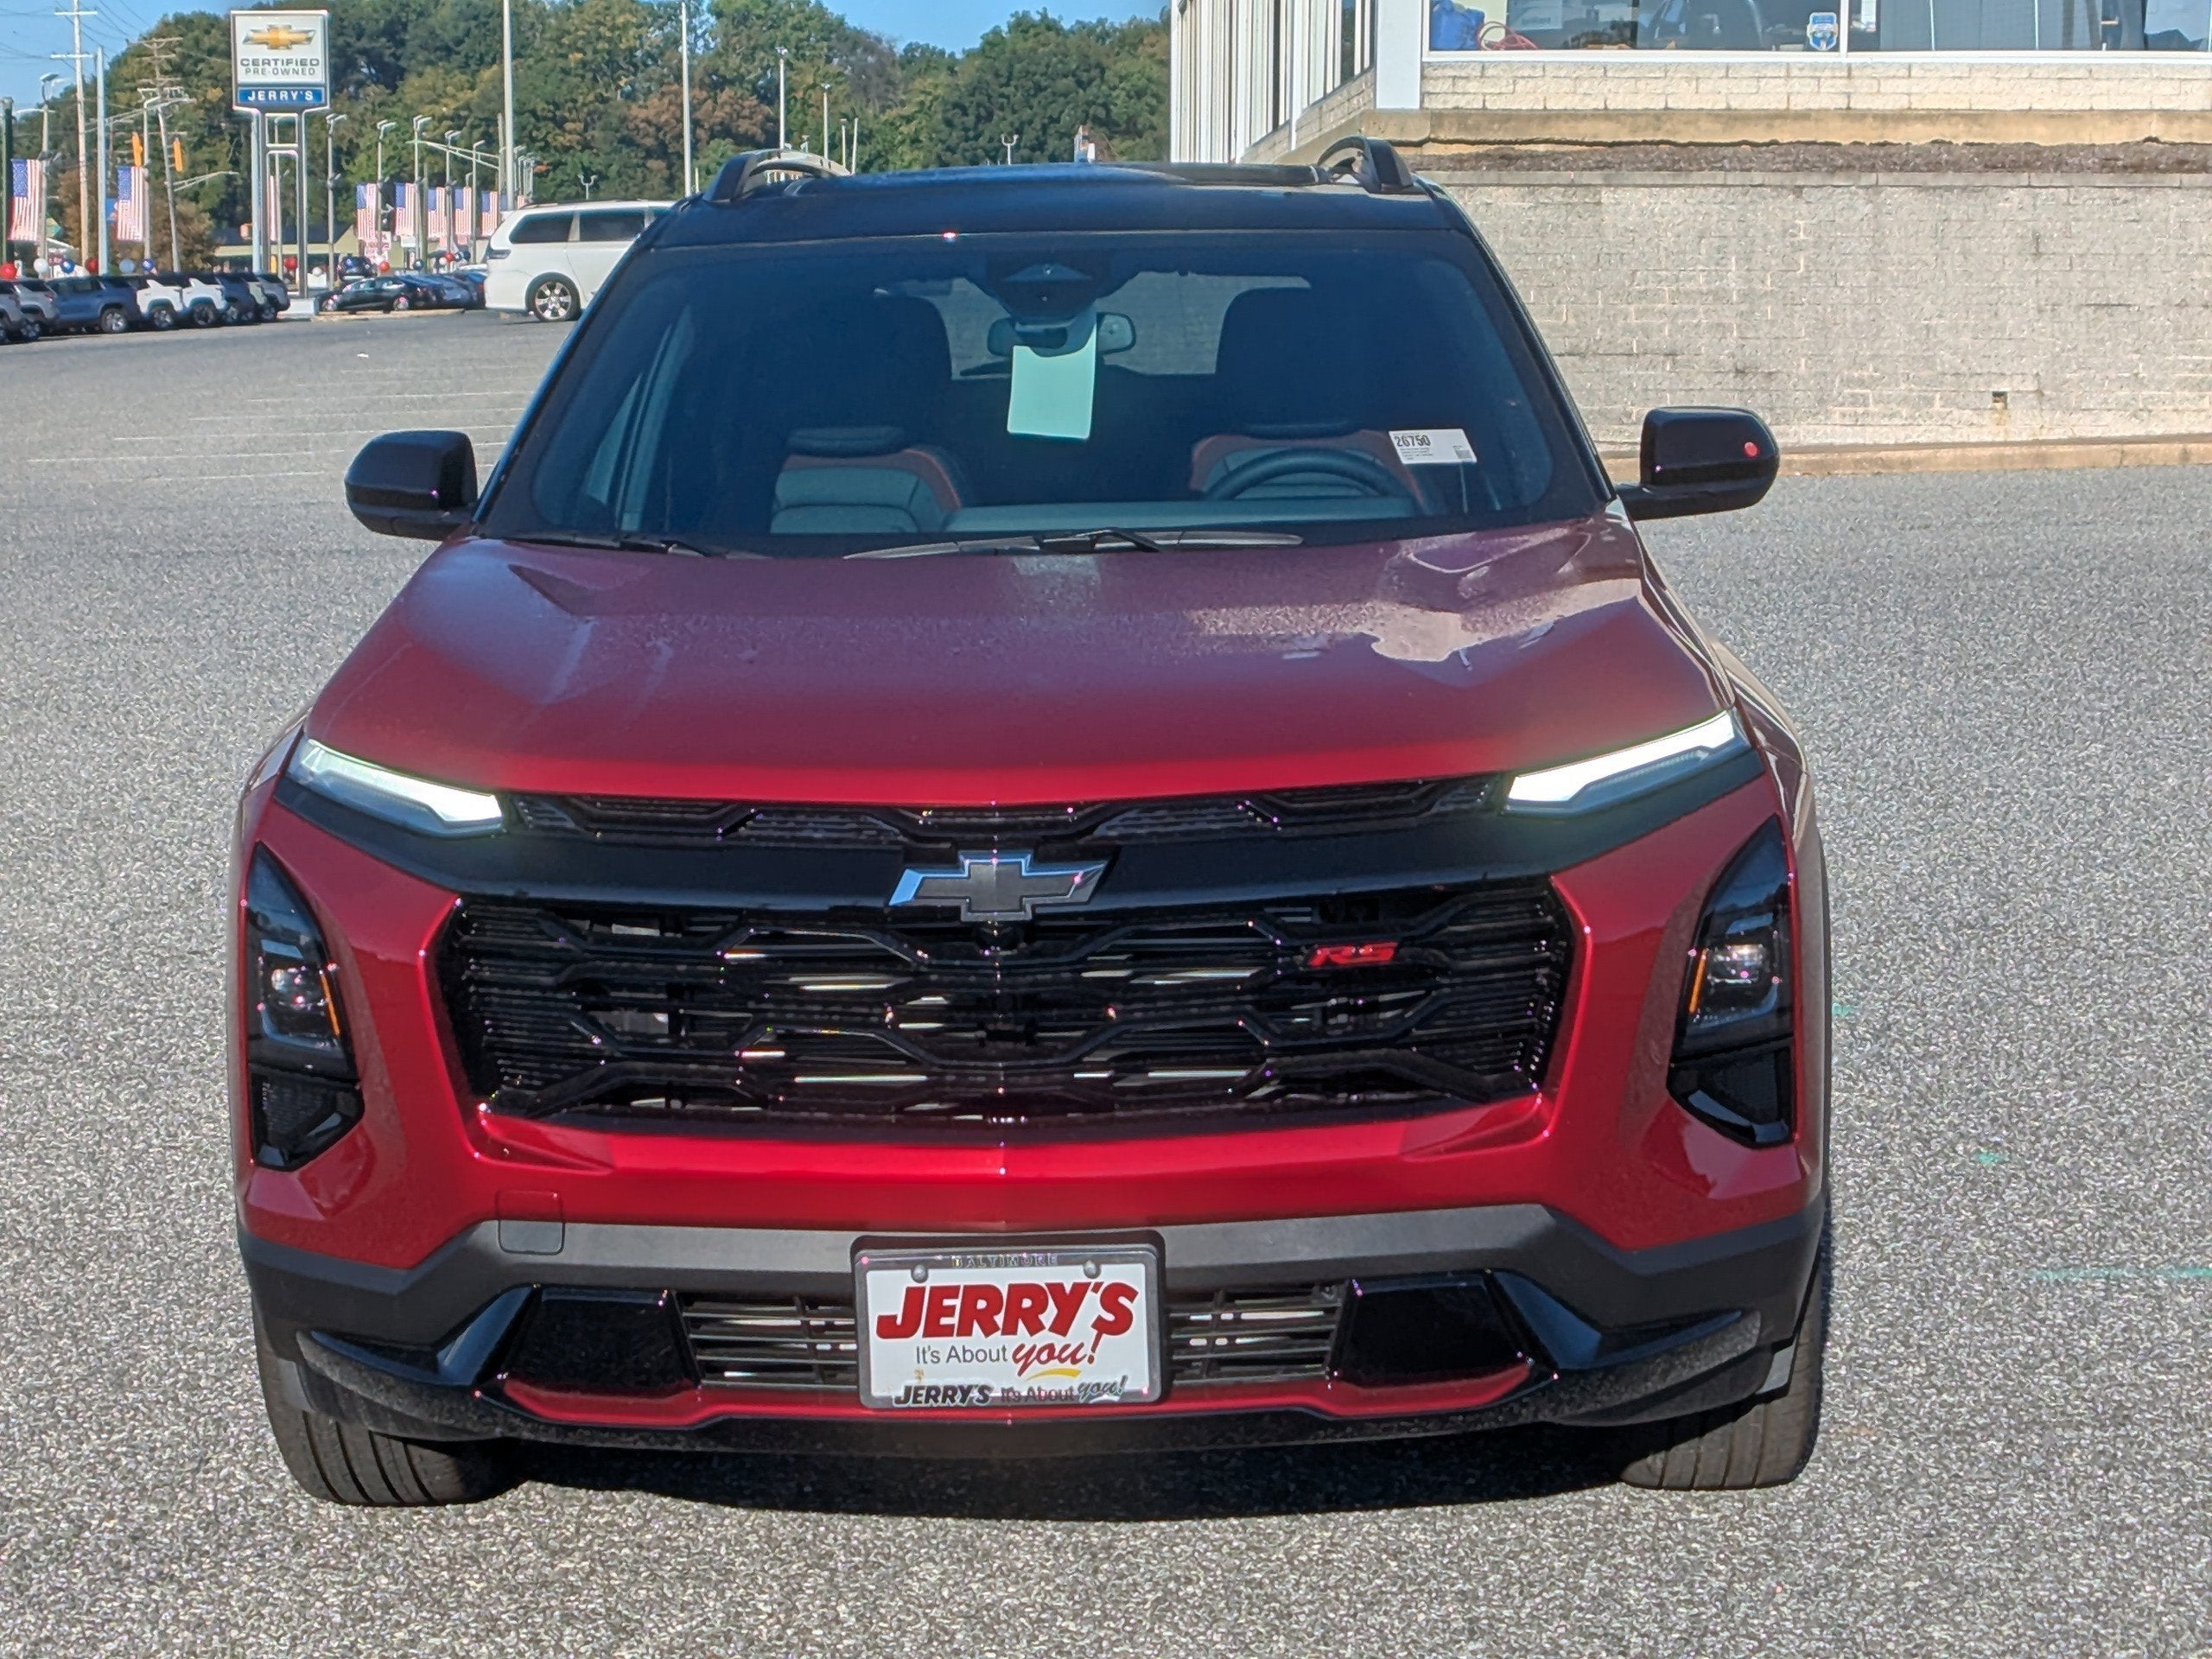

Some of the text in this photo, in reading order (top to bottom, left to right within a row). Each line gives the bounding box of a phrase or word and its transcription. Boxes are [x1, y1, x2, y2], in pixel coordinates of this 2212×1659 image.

[240, 58, 320, 67] CERTIFIED
[245, 67, 315, 76] PRE-OWNED
[248, 90, 314, 101] JERRY'S
[1395, 435, 1431, 447] 26750
[1309, 942, 1398, 967] RS
[951, 1254, 1058, 1268] BALTIMORE
[876, 1281, 1139, 1338] JERRY'S
[916, 1332, 1102, 1376] It's About you!
[893, 1385, 994, 1406] JERRY'S
[1027, 1387, 1074, 1403] About
[1077, 1375, 1128, 1402] you!
